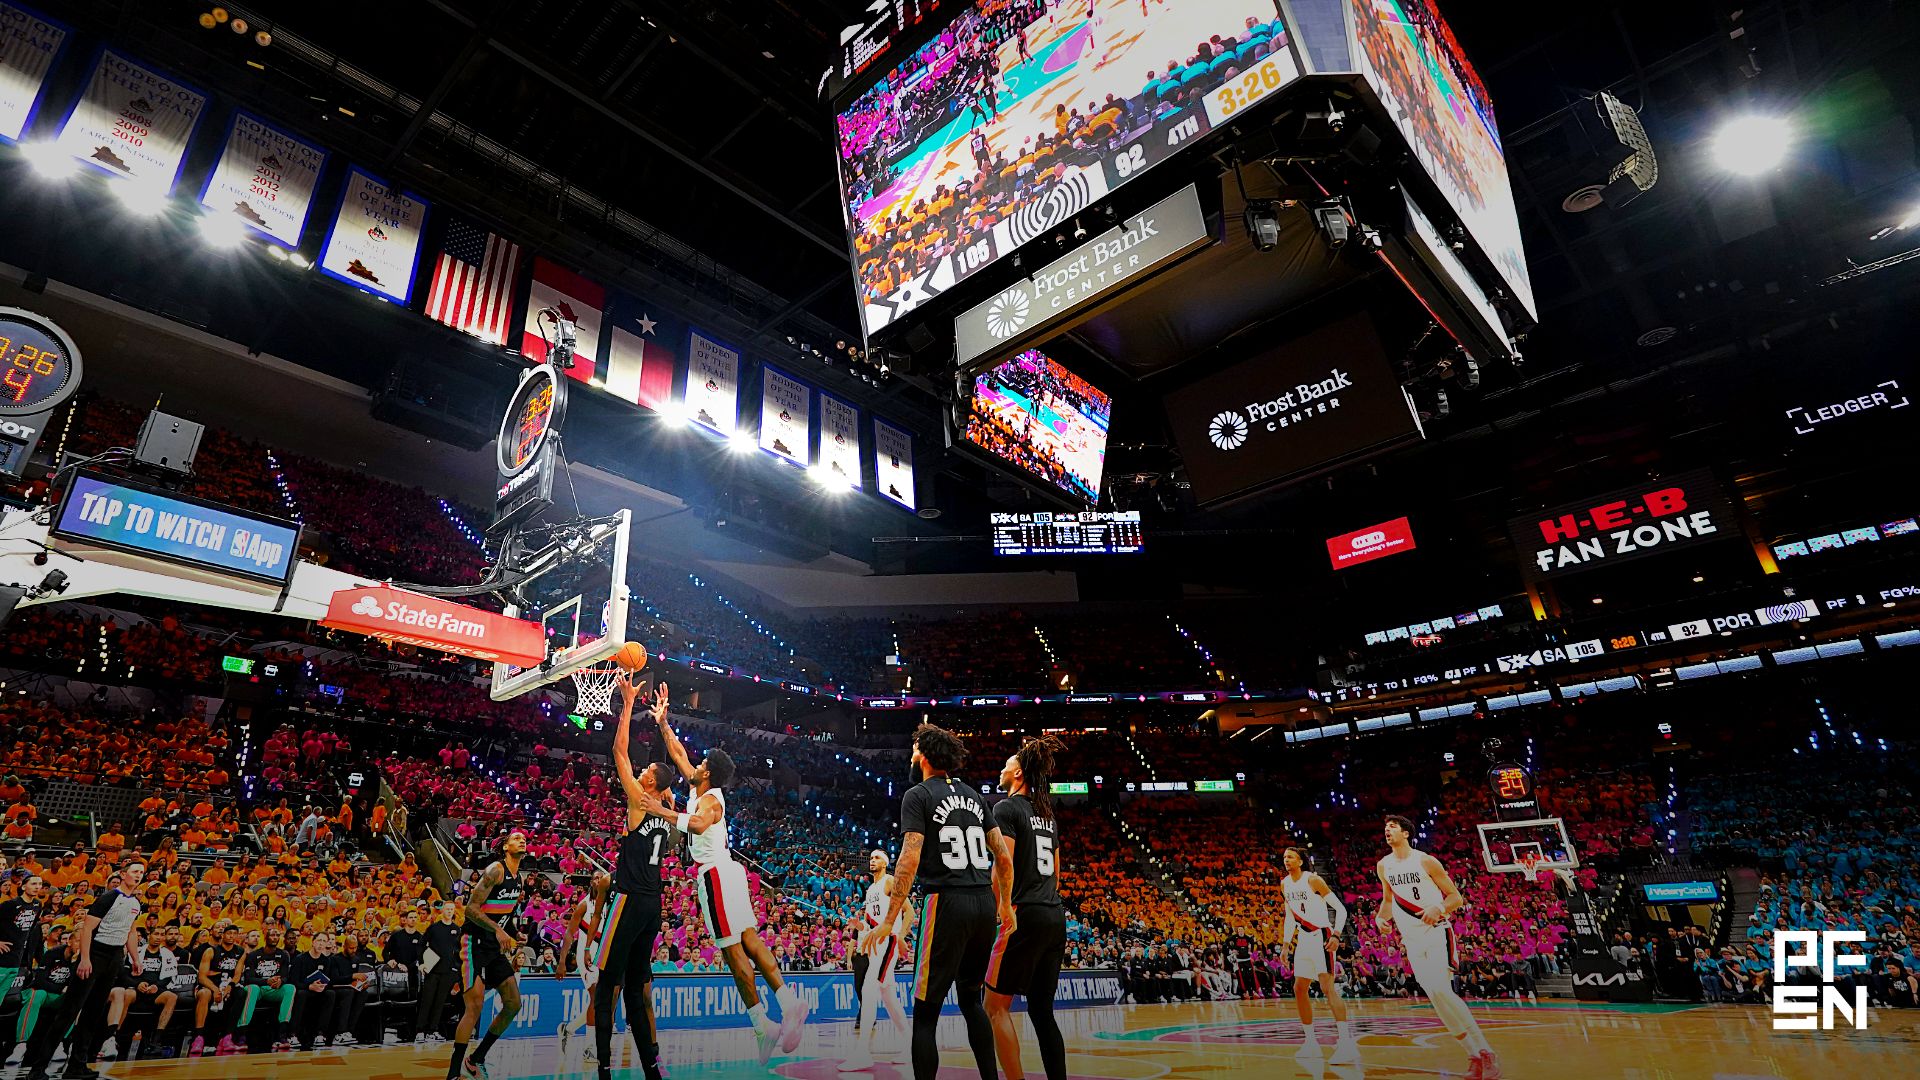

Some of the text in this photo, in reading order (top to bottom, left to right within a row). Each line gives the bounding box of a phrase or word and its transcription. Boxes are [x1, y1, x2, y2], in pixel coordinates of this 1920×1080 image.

[104, 54, 203, 106] RODEO OF
[1217, 61, 1281, 116] 3:26
[101, 68, 194, 118] THE YEAR
[115, 117, 148, 137] 2009
[120, 110, 153, 128] 2008
[1167, 115, 1199, 147] 4TH
[112, 128, 143, 147] 2010
[239, 118, 322, 161] RODEO OF
[236, 128, 317, 173] THE YEAR
[1115, 143, 1147, 178] 92
[252, 175, 279, 192] 2012
[256, 166, 281, 182] 2011
[249, 185, 276, 202] 2013
[364, 181, 412, 208] RODEO
[359, 191, 411, 221] OF THE
[364, 208, 400, 229] YEAR
[957, 239, 990, 275] 105
[1033, 217, 1159, 300] Frost Bank
[1051, 254, 1140, 308] CENTER
[697, 351, 731, 371] OF THE
[699, 340, 730, 360] RODEO
[702, 363, 725, 379] YEAR
[770, 383, 801, 403] OF THE
[772, 374, 802, 393] RODEO
[1245, 368, 1352, 423] Frost Bank
[775, 396, 797, 411] YEAR
[1266, 398, 1340, 432] CENTER
[1804, 392, 1889, 425] LEDGER
[1036, 513, 1051, 522] 105
[1082, 512, 1094, 522] 92
[79, 492, 283, 568] TAP TO WATCH App
[1536, 511, 1718, 572] FAN ZONE
[1826, 598, 1847, 610] PF
[1543, 648, 1567, 663] SA
[1575, 643, 1597, 656] 105
[1611, 635, 1637, 650] 3:26
[1681, 624, 1700, 637] 92
[1712, 613, 1754, 632] POR
[1383, 682, 1398, 690] TO
[1413, 674, 1439, 685] FG%
[1462, 666, 1477, 676] PF
[1500, 768, 1523, 780] 3:26
[1498, 778, 1526, 797] 24
[649, 834, 663, 866] 1
[938, 825, 991, 870] 30
[1035, 834, 1055, 876] 5
[1412, 886, 1421, 900] 8
[1300, 902, 1306, 914] 4
[675, 987, 701, 1017] THE
[832, 983, 854, 1010] TAP
[1072, 978, 1089, 1000] THE
